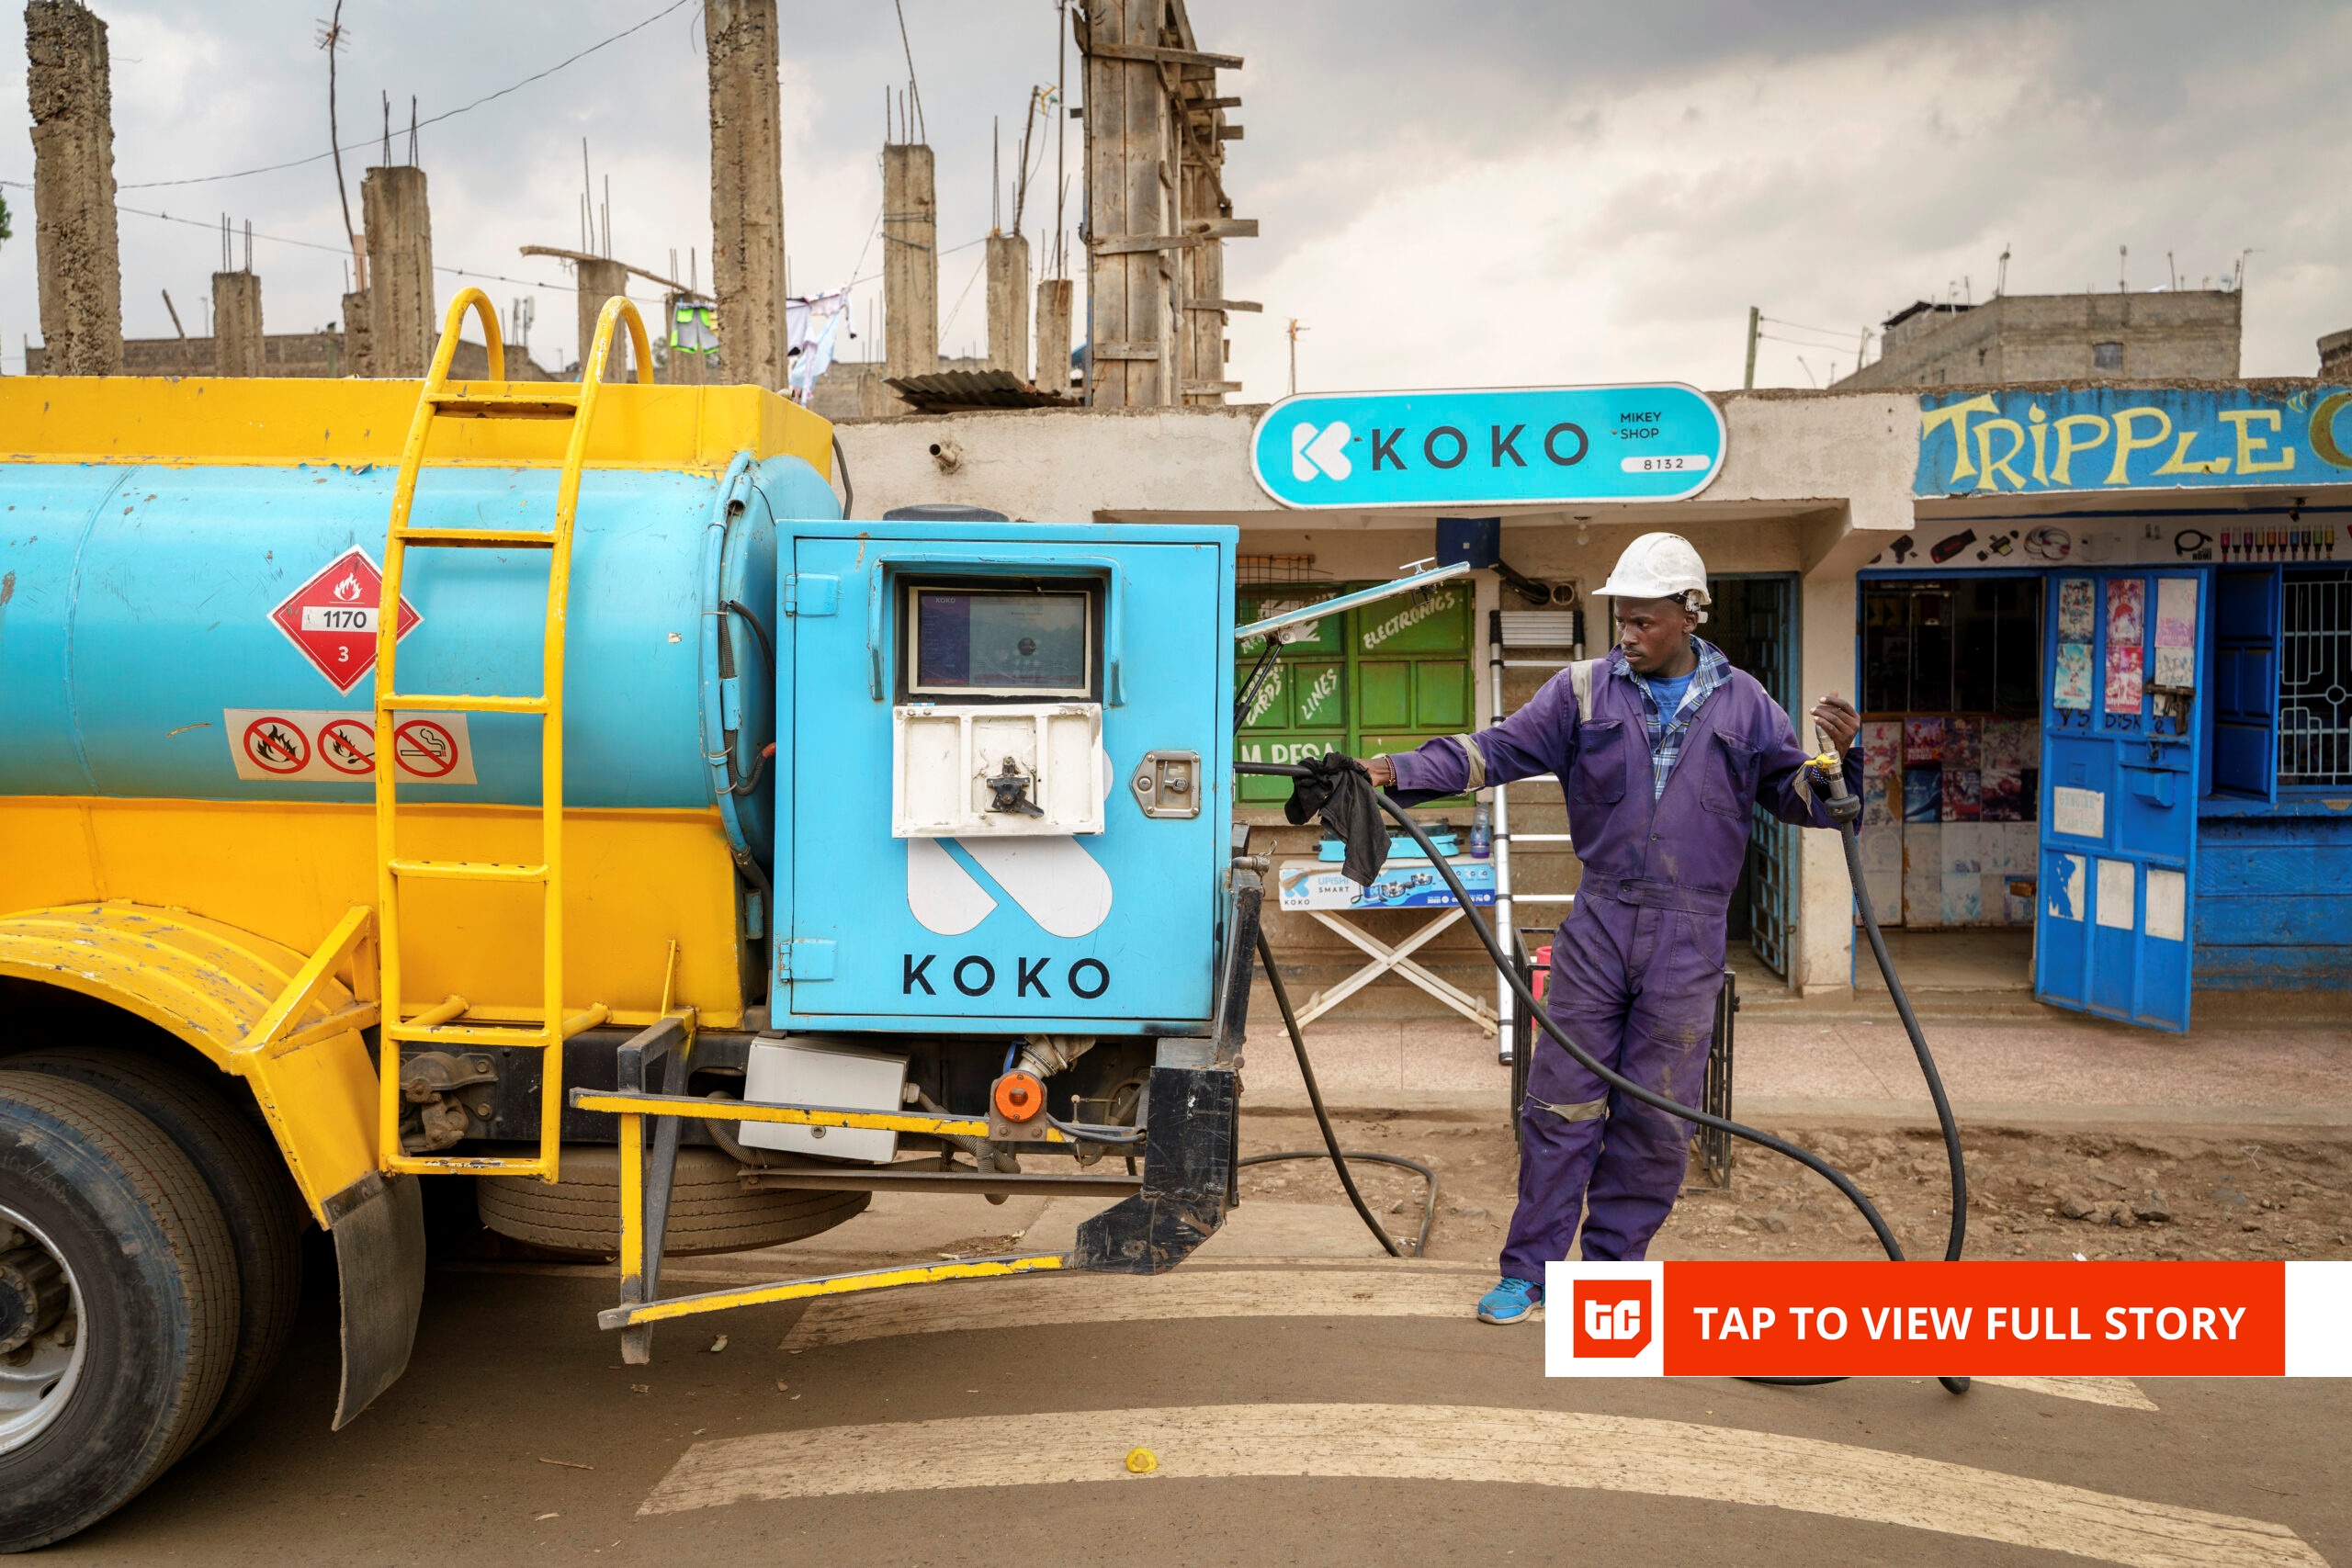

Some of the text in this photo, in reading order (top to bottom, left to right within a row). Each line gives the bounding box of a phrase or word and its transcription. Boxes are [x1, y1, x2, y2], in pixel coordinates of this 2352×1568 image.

[1620, 412, 1662, 423] MIKEY
[1620, 427, 1659, 440] SHOP
[1372, 423, 1589, 470] KOKO
[1644, 458, 1684, 470] 8132
[323, 611, 367, 628] 1170
[1363, 592, 1455, 649] ELECTRONICS
[338, 646, 349, 662] 3
[1301, 669, 1337, 720] LINES
[903, 953, 1110, 998] KOKO
